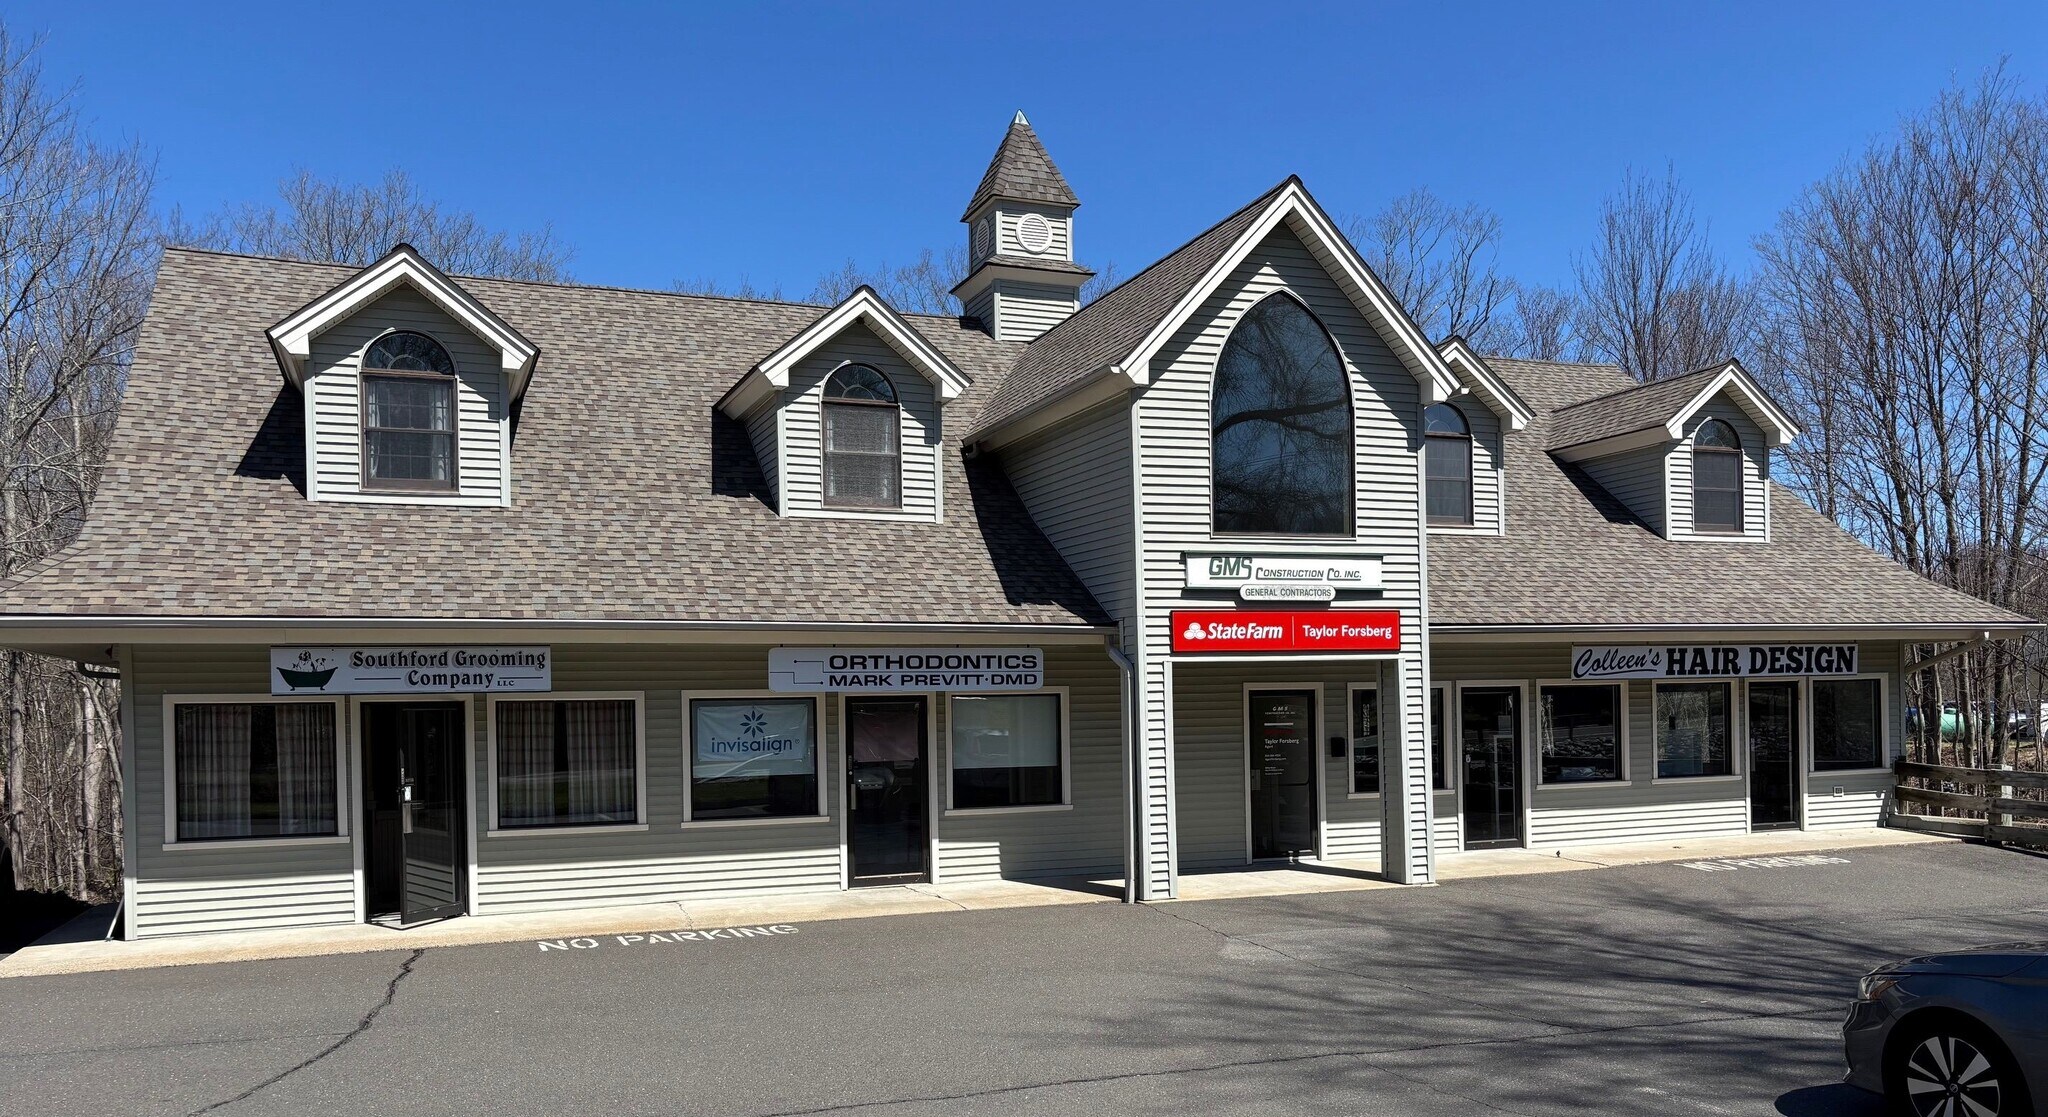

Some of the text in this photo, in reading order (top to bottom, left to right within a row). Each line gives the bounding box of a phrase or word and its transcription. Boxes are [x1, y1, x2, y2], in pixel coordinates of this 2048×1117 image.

[1208, 556, 1253, 580] GMS
[1344, 569, 1362, 580] INC.
[1244, 587, 1332, 598] GENERAL CONTRACTORS
[1302, 624, 1339, 640] Taylor
[1340, 624, 1393, 640] Forsberg
[351, 649, 547, 671] Southford Grooming
[828, 654, 1039, 671] ORTHODONTICS
[1572, 645, 1856, 679] Colleen's HAIR DESIGN
[407, 669, 516, 689] Company LLC
[828, 674, 894, 688] MARK
[711, 736, 793, 756] invisalign
[1279, 737, 1300, 745] Forsberg
[536, 924, 800, 952] NO PARKING
